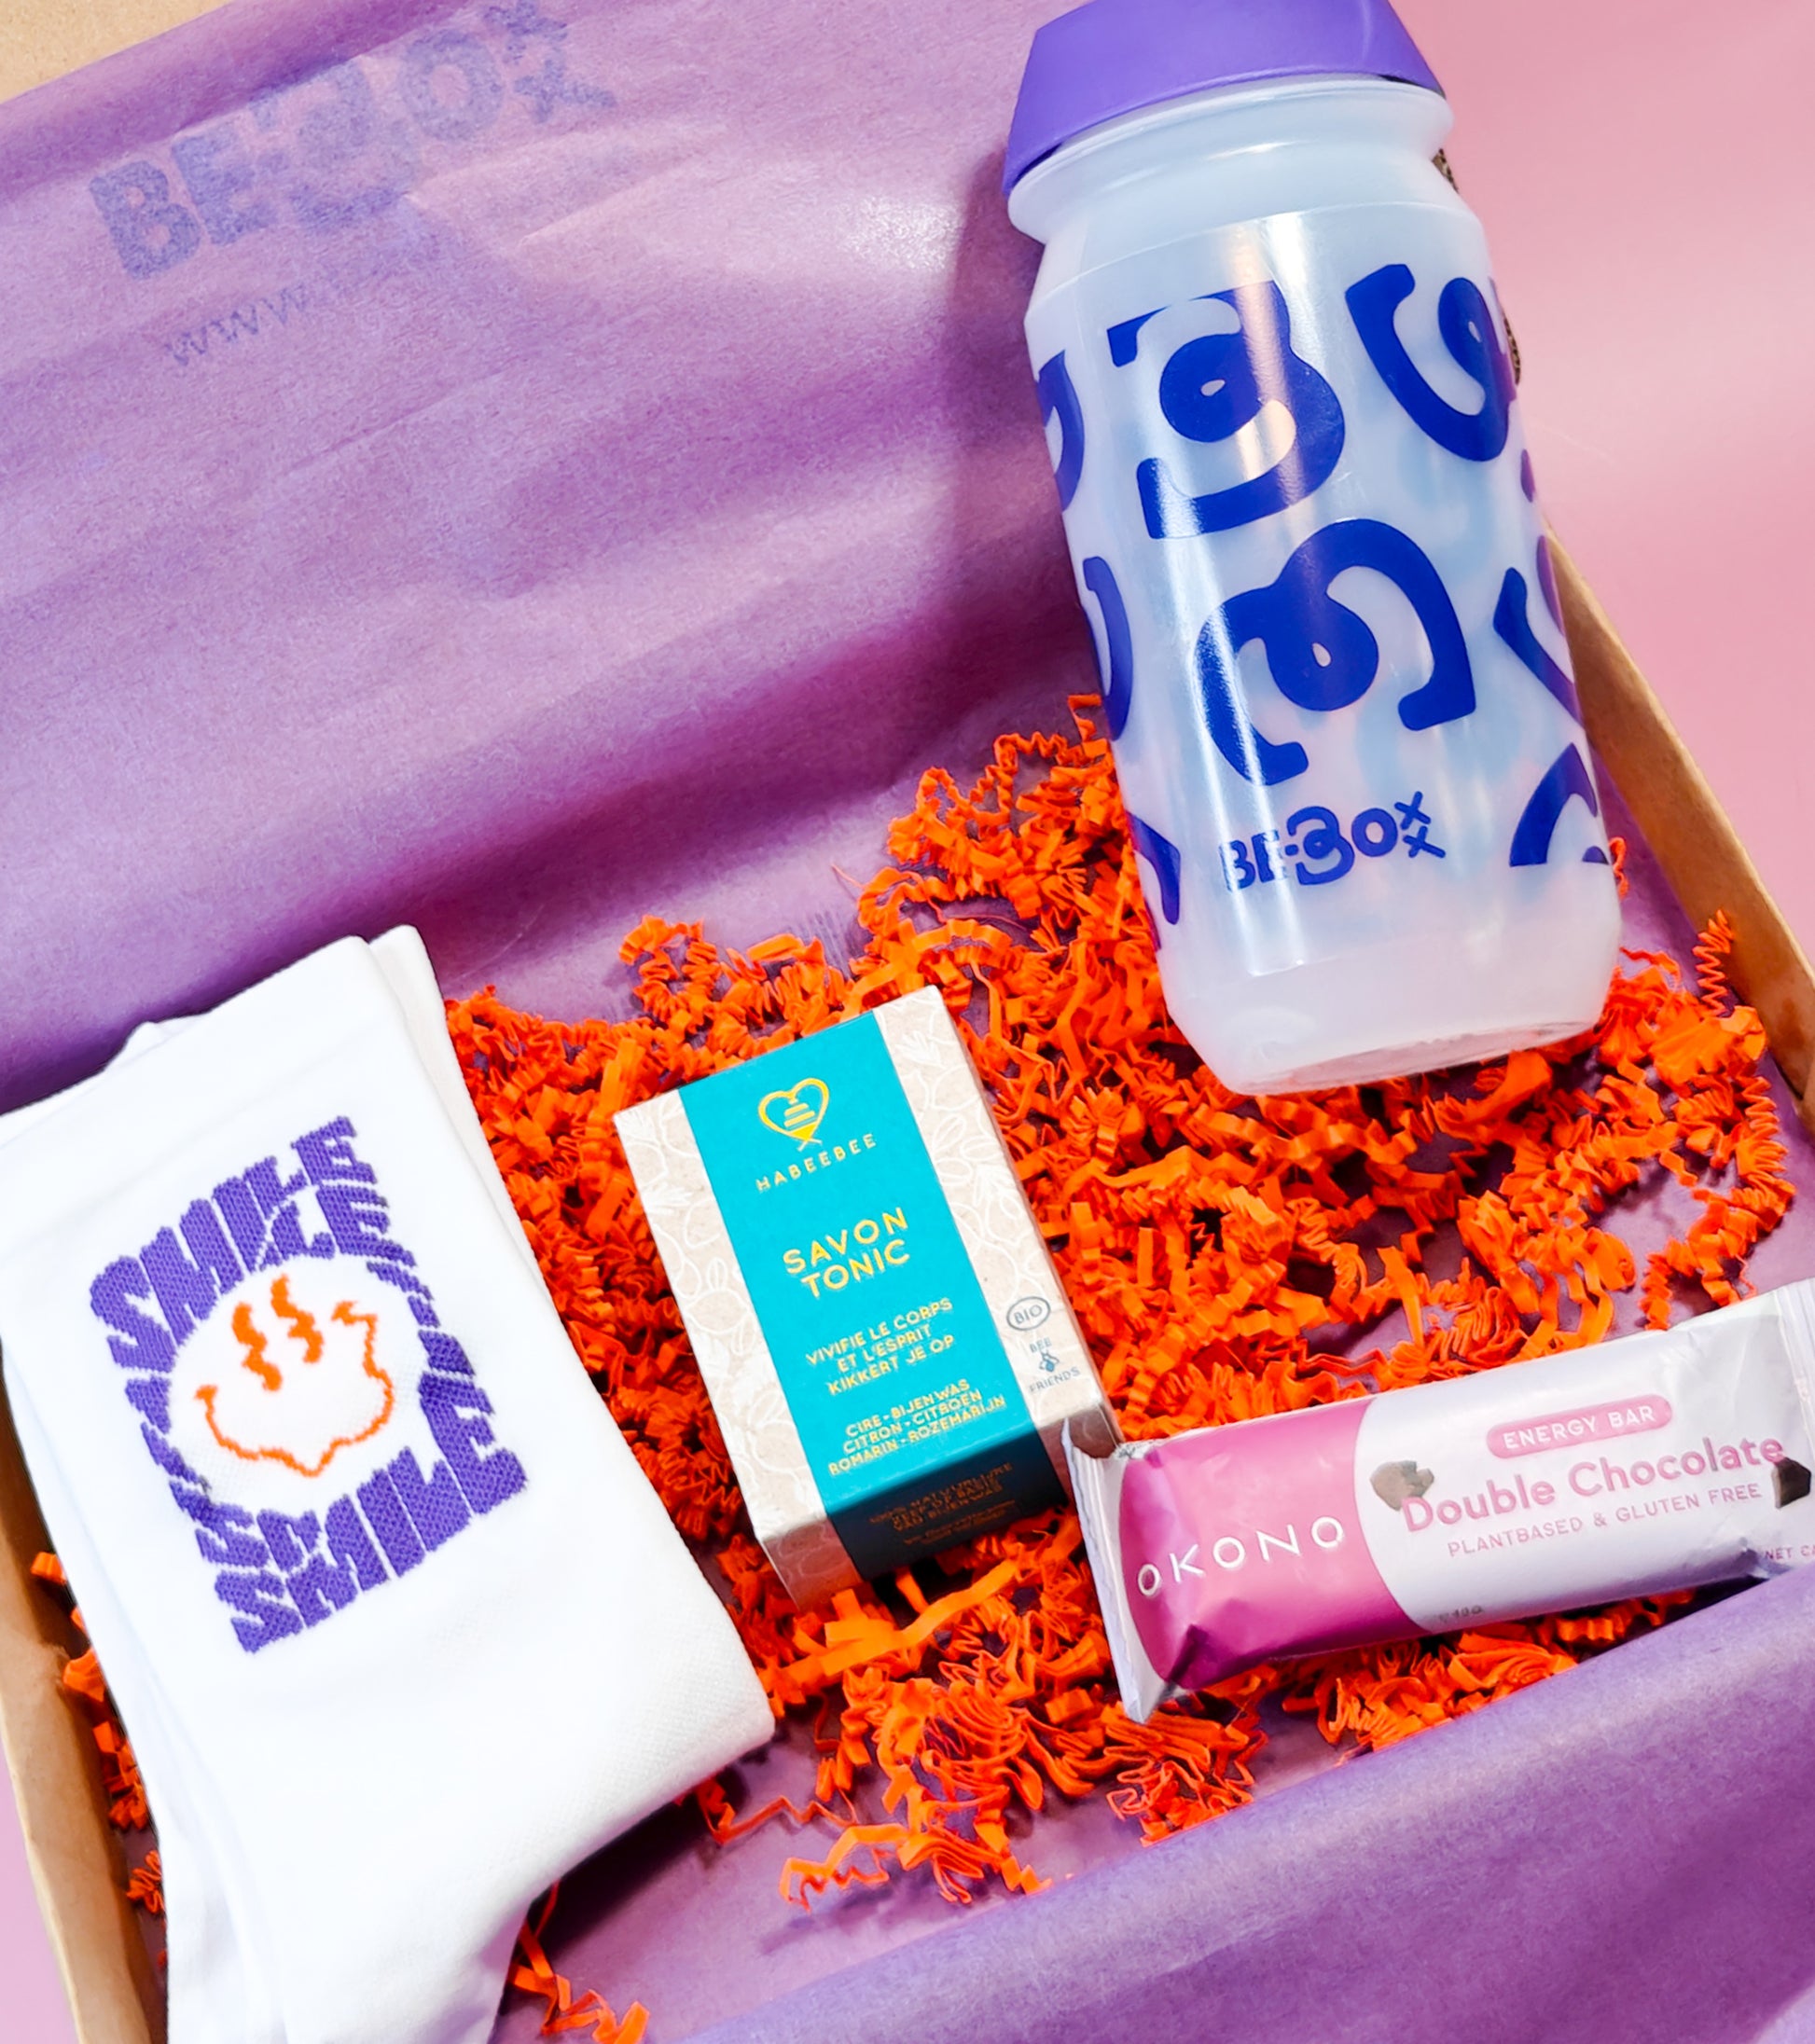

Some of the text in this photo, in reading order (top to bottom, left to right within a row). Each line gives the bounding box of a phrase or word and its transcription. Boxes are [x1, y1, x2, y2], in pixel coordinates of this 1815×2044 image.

[755, 1133, 877, 1194] HABEEBEE
[90, 1115, 378, 1374] SMILE
[783, 1207, 908, 1275] SAVON
[800, 1238, 910, 1300] TONIC
[805, 1297, 953, 1366] VIVIFIE LE CORPS
[1013, 1305, 1043, 1325] BIO
[1029, 1337, 1053, 1354] BEE
[826, 1334, 954, 1396] KIKKERT JE OP
[837, 1353, 857, 1374] ET
[1029, 1365, 1081, 1393] FRIENDS
[828, 1439, 898, 1477] ROMARIN
[908, 1395, 1006, 1444] ROZEMARIJN
[843, 1422, 903, 1455] CITRON
[845, 1414, 882, 1438] CIRE
[1503, 1405, 1656, 1451] ENERGY BAR
[213, 1371, 529, 1654] SMILE
[1401, 1436, 1785, 1533] Double Chocolate
[1447, 1483, 1764, 1558] PLANTBASED & GLUTEN FREE
[1137, 1515, 1345, 1597] OKONO
[1765, 1546, 1793, 1560] NET
